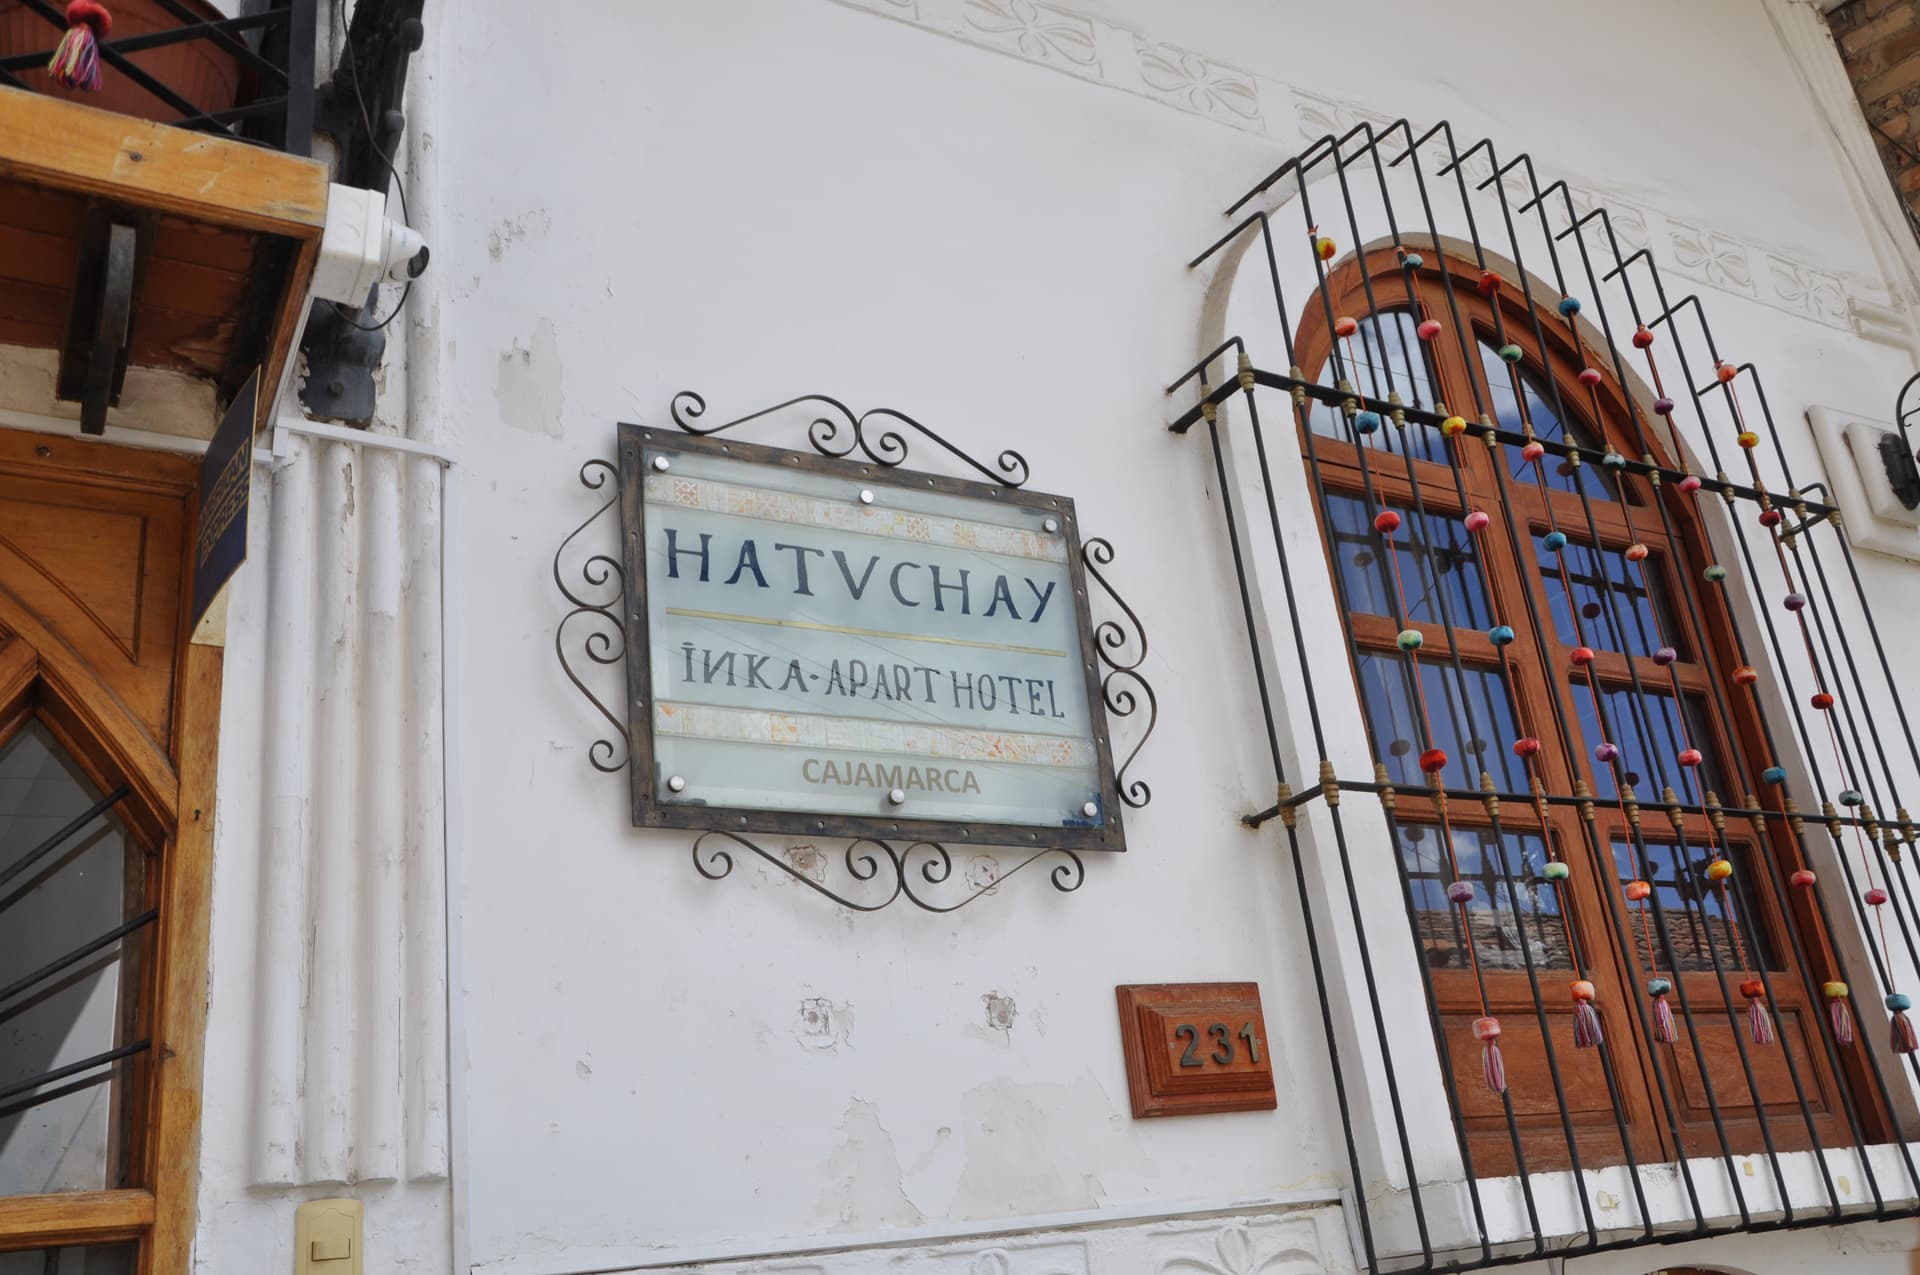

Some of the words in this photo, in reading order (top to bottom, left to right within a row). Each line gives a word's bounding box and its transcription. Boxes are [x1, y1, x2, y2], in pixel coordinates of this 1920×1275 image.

[951, 671, 1066, 719] HOTEL
[802, 758, 982, 795] CAJAMARCA
[1175, 1021, 1261, 1068] 231
